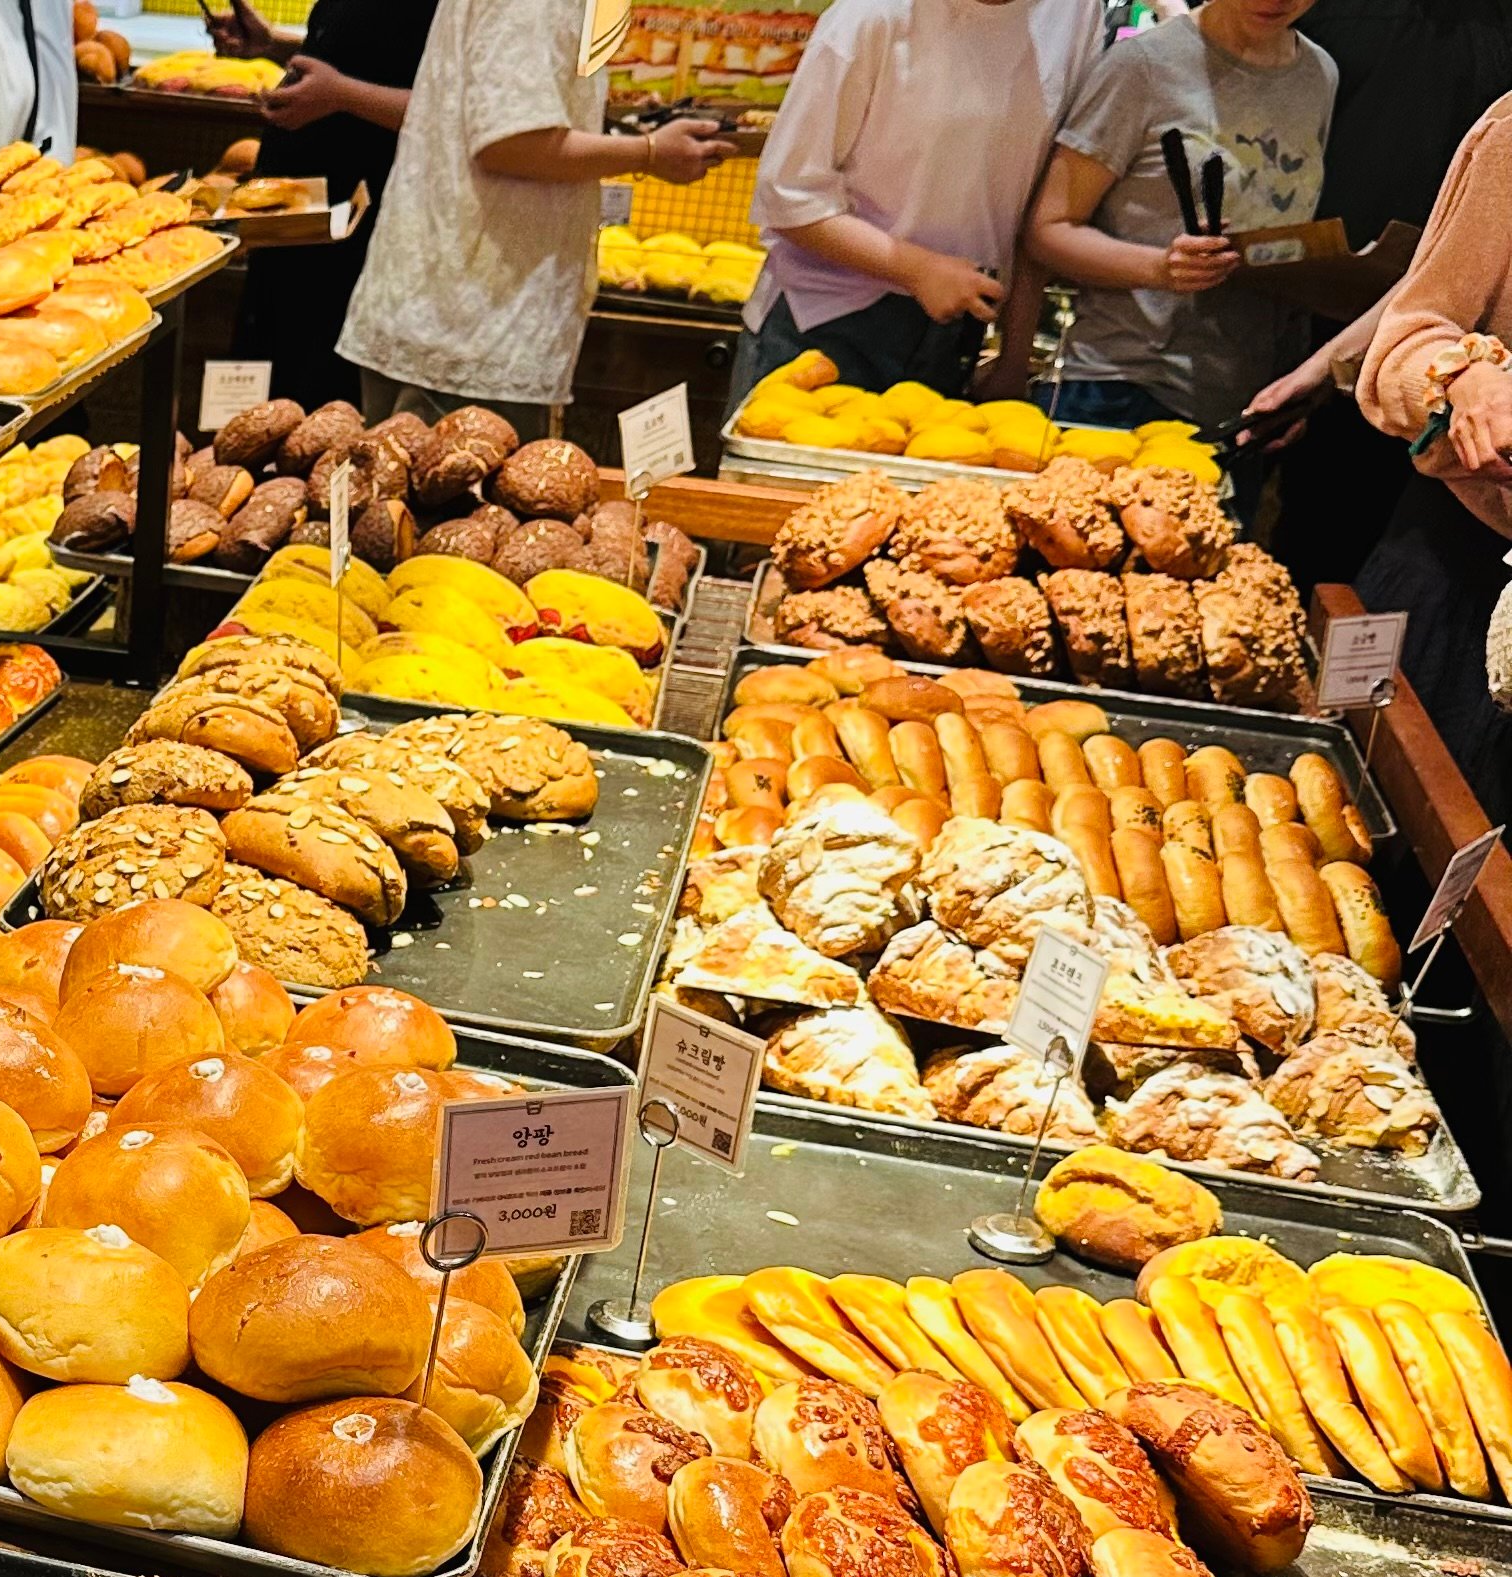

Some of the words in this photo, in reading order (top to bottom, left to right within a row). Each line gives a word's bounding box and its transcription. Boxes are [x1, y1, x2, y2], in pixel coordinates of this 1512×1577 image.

[676, 1040, 726, 1071] 슈크림빵
[513, 1125, 554, 1148] 앙팡
[473, 1157, 497, 1166] Fresh
[497, 1154, 524, 1164] cream
[525, 1152, 540, 1161] red
[498, 1204, 557, 1223] 3,000원
